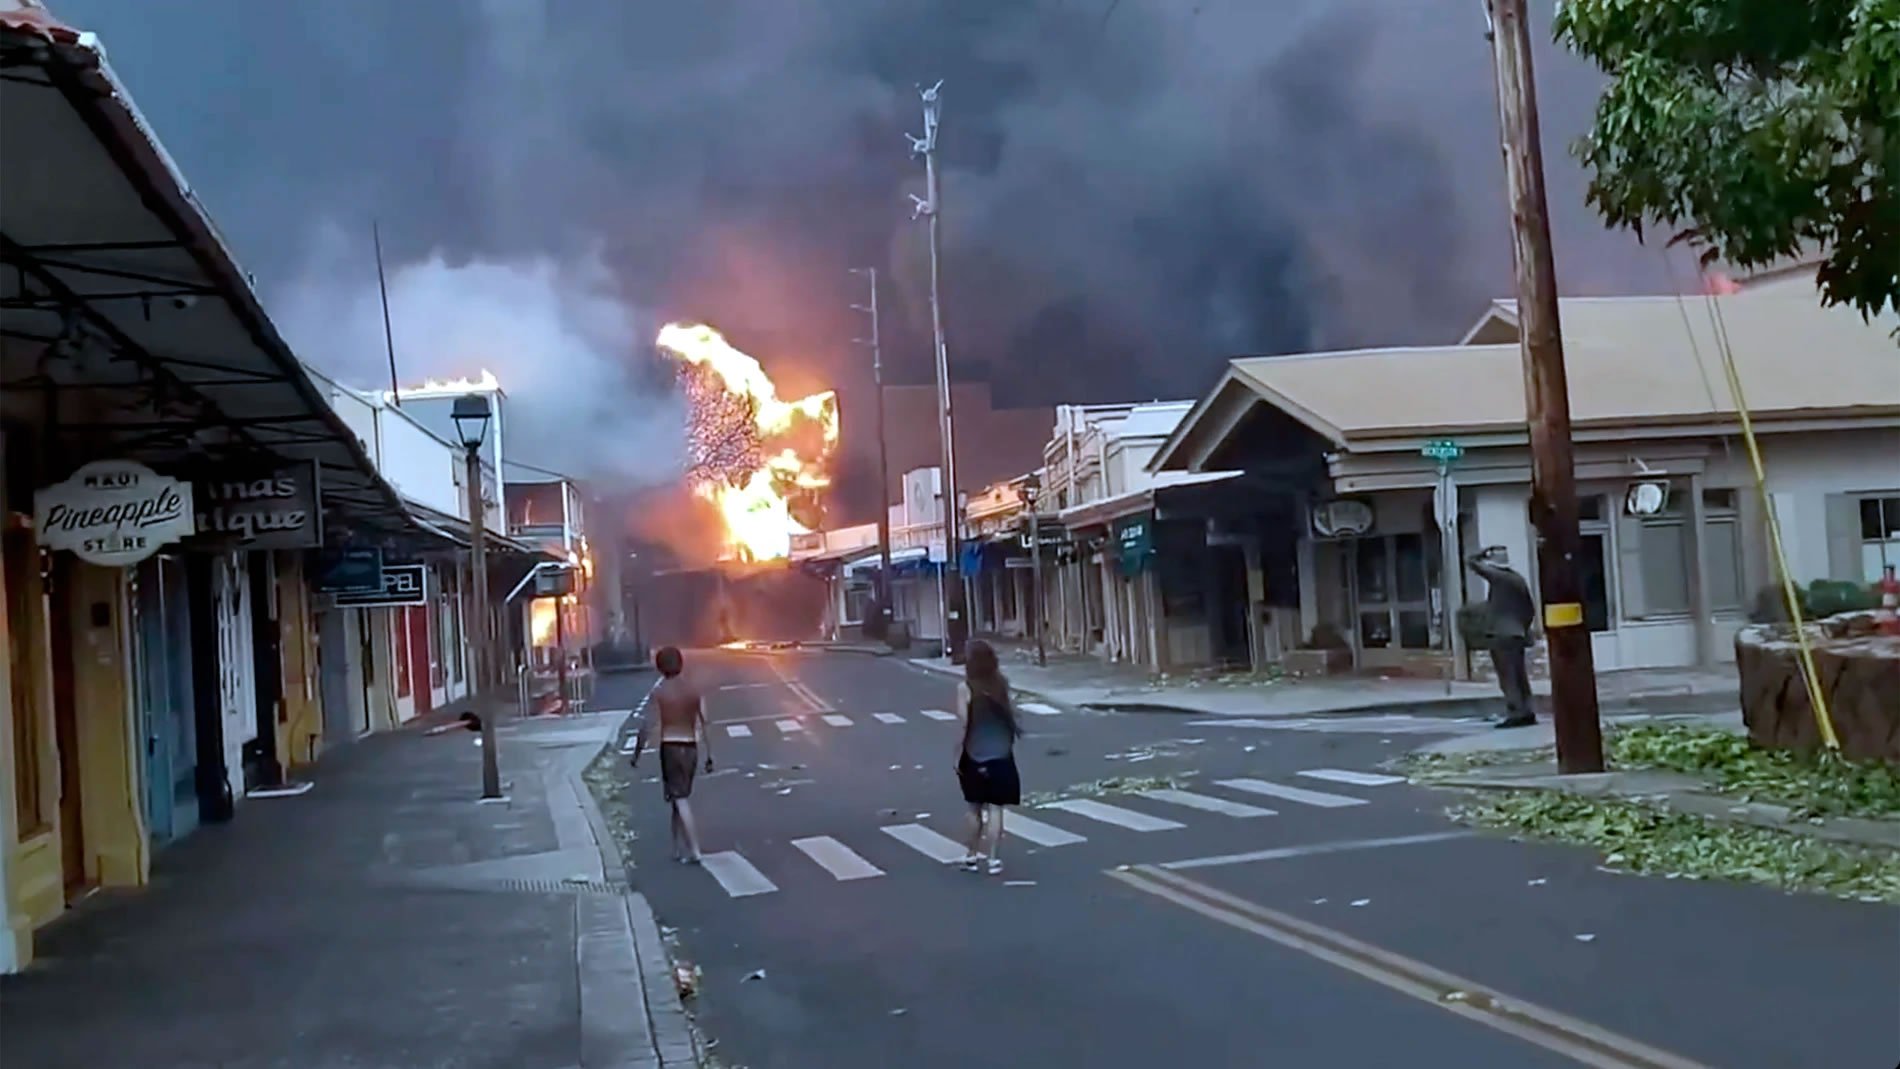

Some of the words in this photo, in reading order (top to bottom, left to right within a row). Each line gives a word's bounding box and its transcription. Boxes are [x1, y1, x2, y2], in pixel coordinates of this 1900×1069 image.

[84, 472, 139, 487] MAUI
[43, 486, 182, 534] Pineapple
[83, 536, 147, 552] STRE
